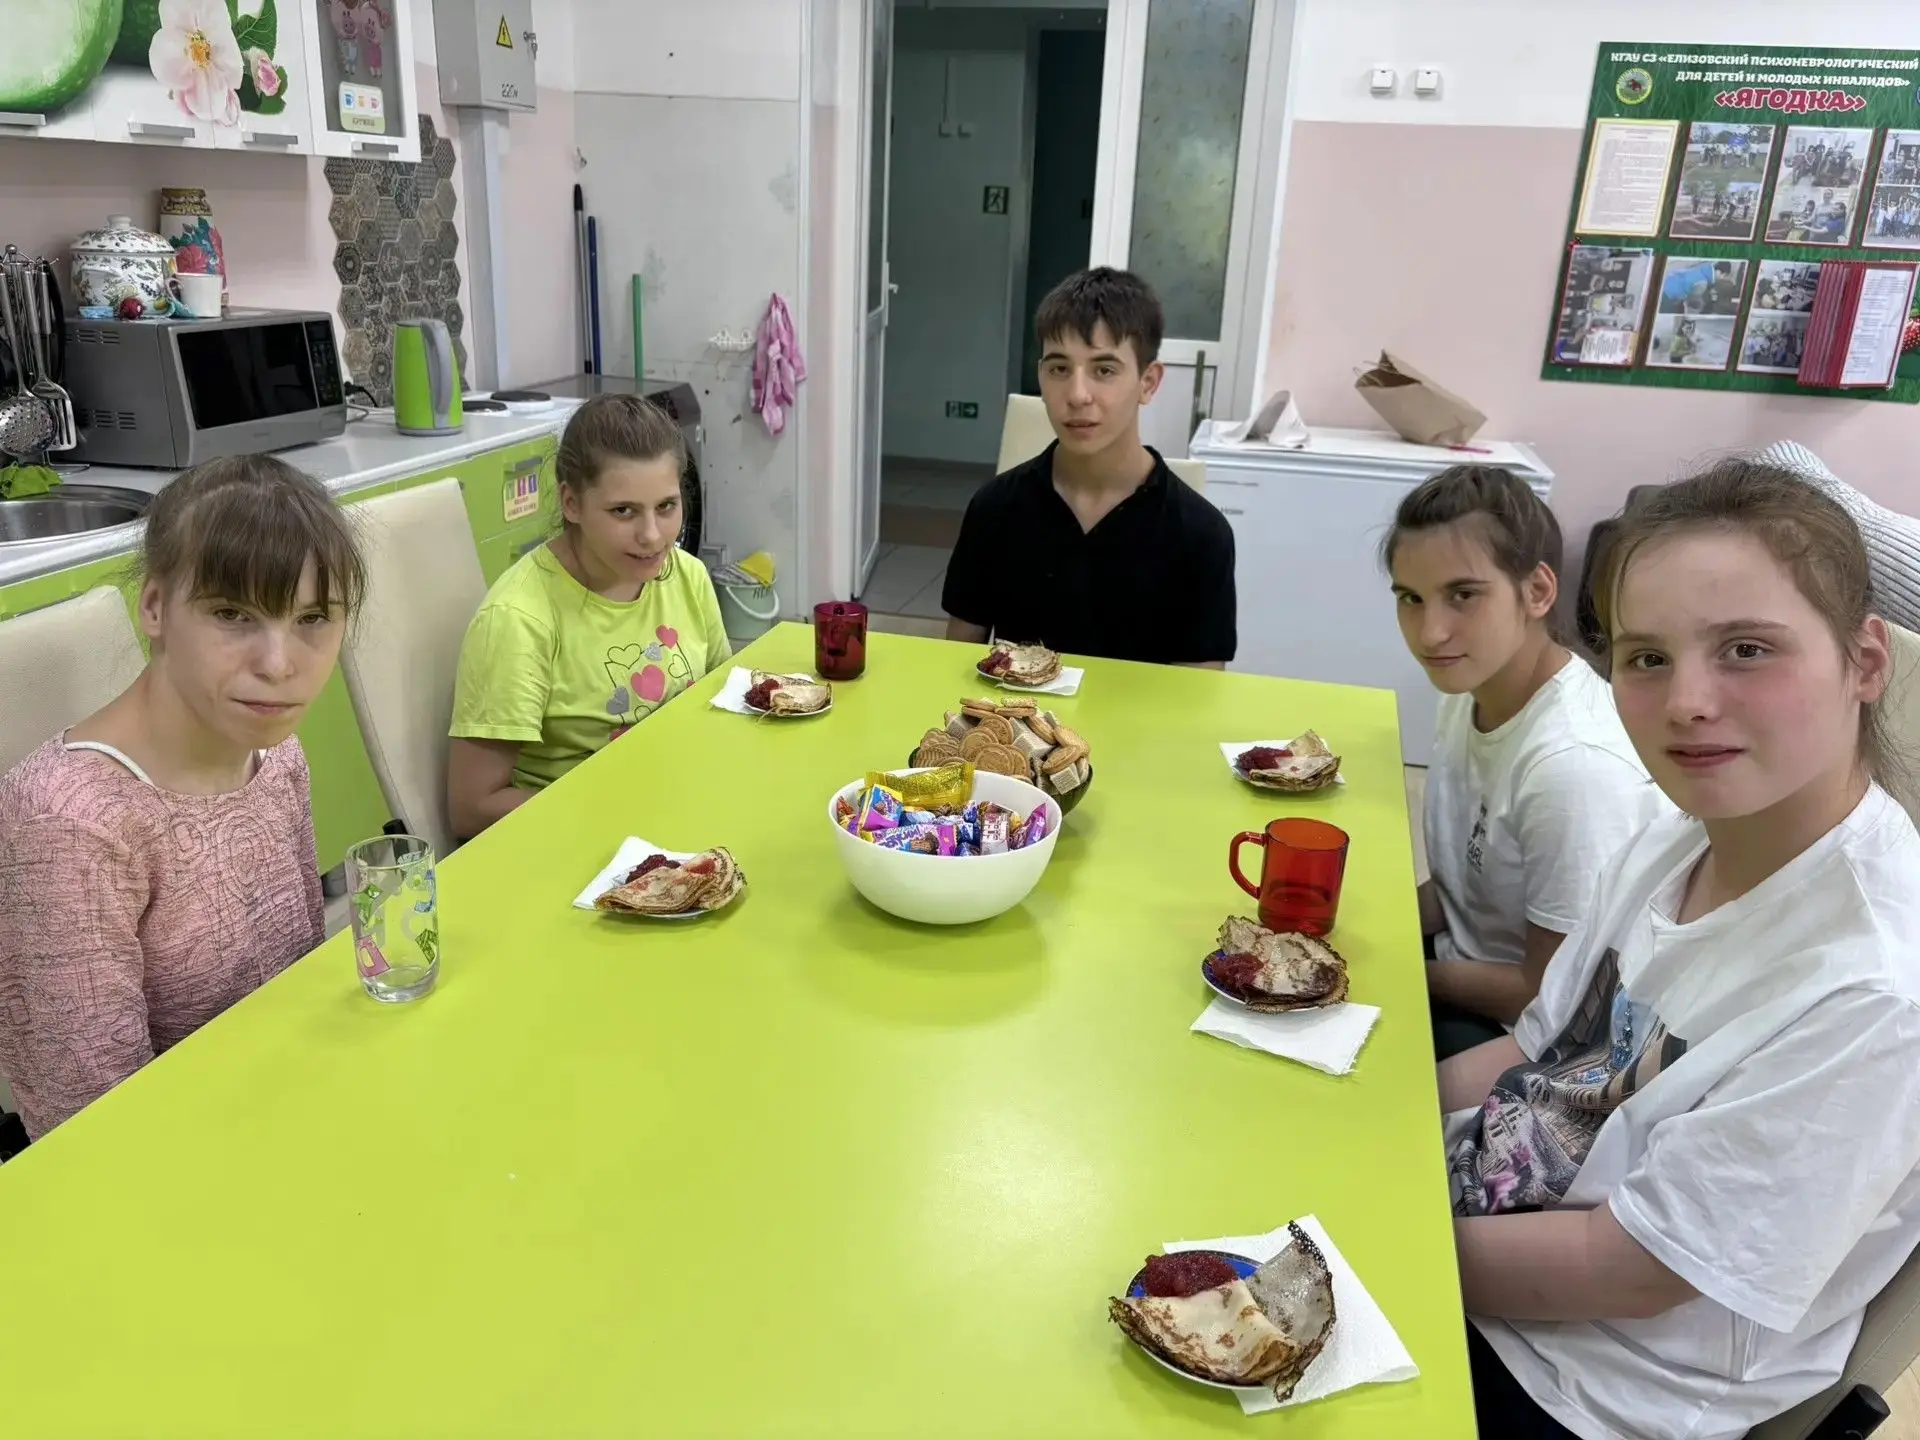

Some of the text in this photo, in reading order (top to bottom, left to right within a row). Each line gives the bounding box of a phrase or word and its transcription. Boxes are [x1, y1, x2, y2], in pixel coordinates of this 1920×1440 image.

[1611, 53, 1918, 69] КГАУ СЗ «ЕЛИЗОВСКИЙ ПСИХОНЕВРОЛОГИЧЕСКИЙ
[1675, 71, 1910, 87] ДЛЯ ДЕТЕЙ И МОЛОДЫХ ИНВАЛИДОВ»
[1714, 88, 1866, 114] «ЯГОДКА»
